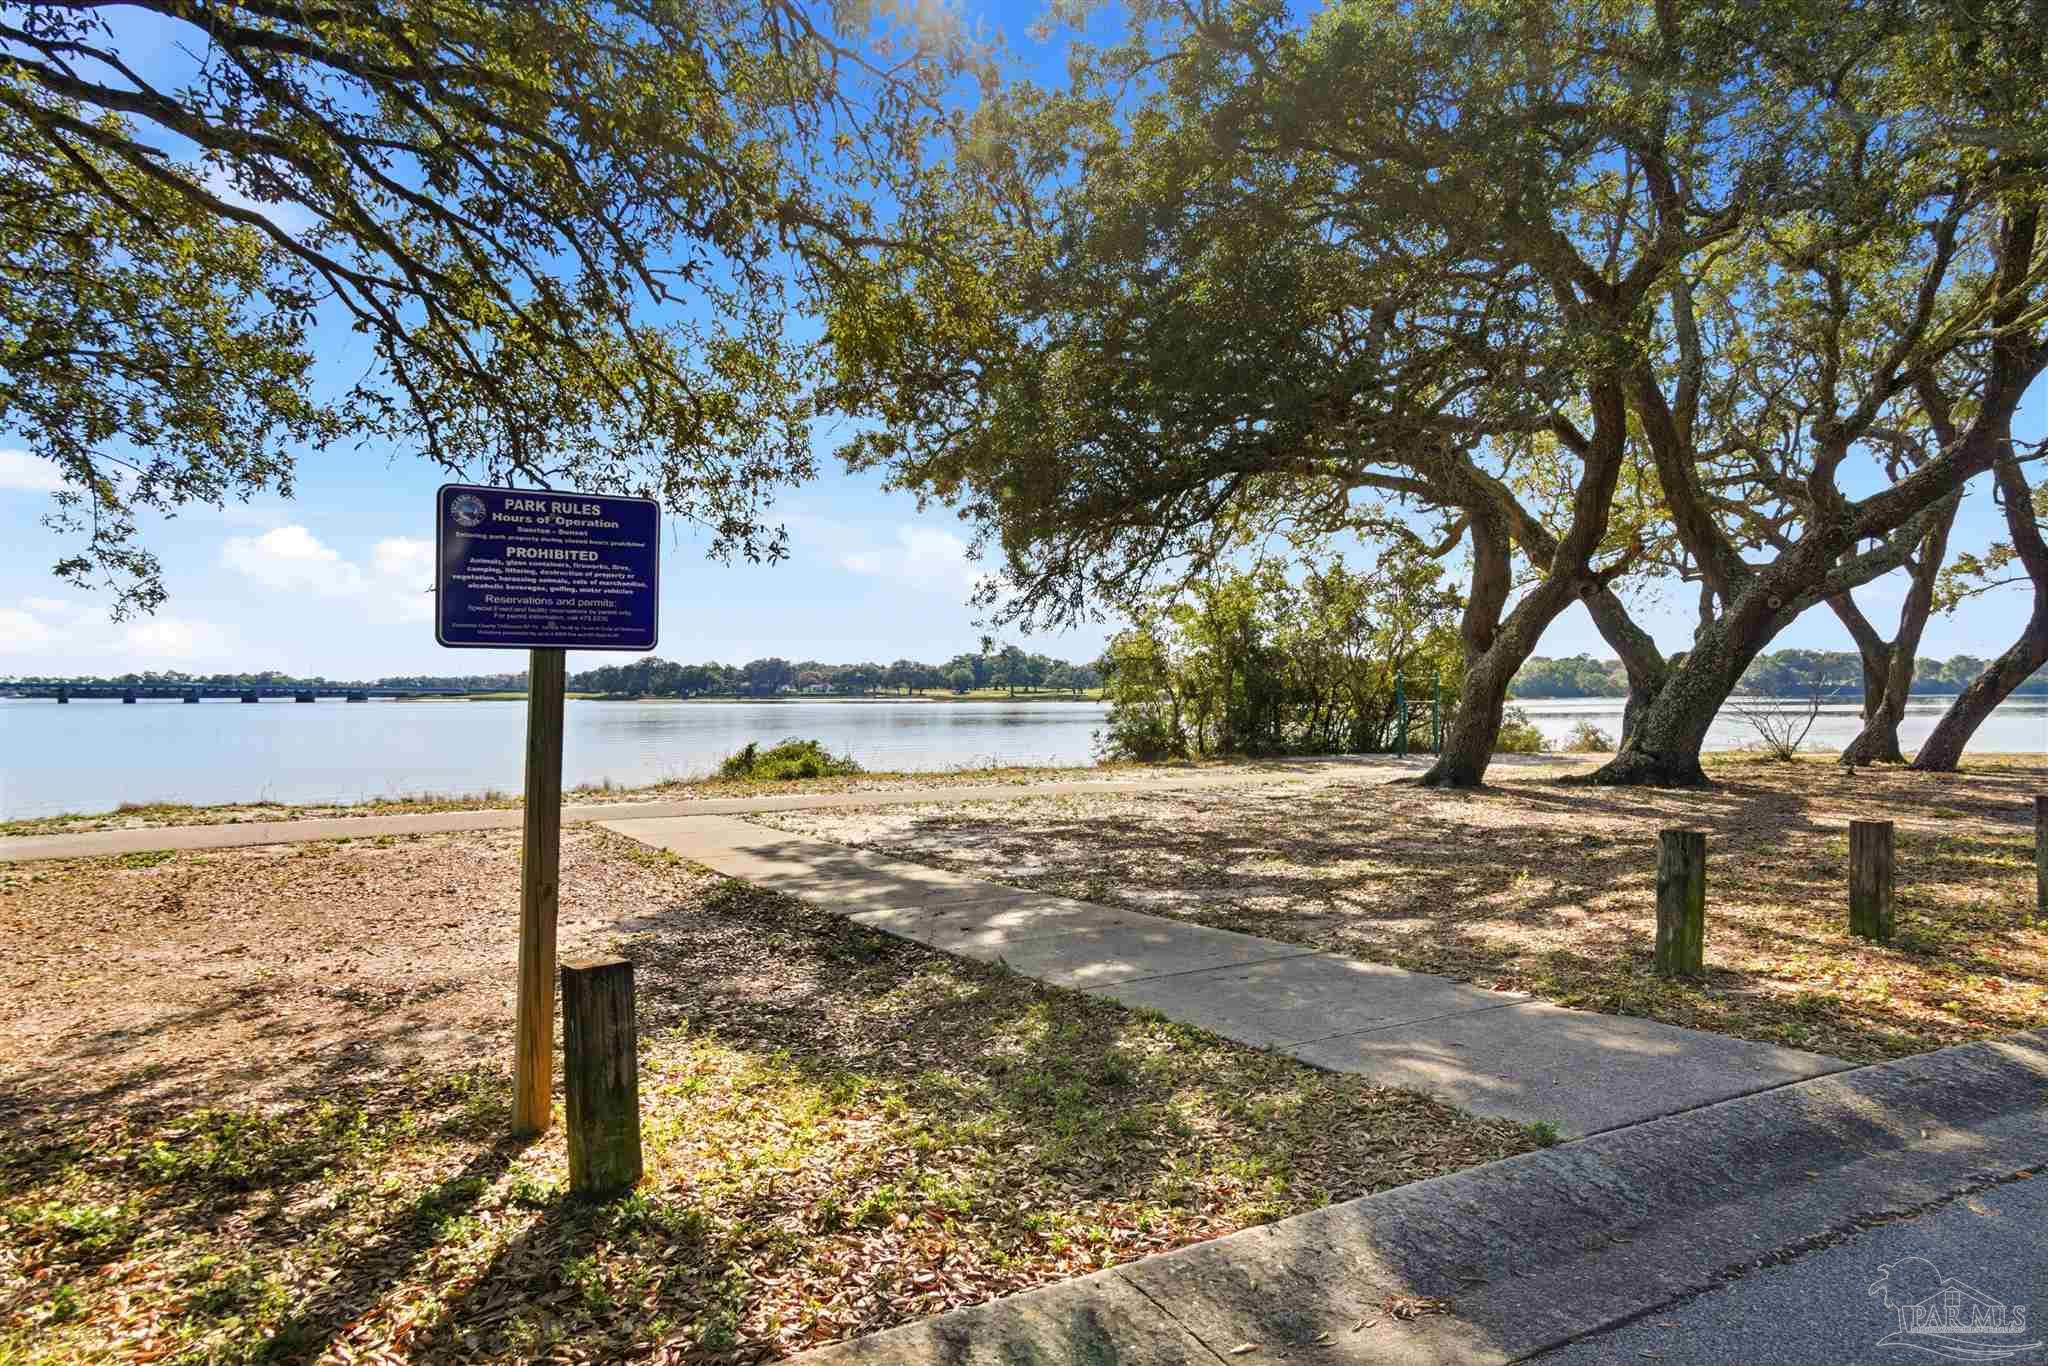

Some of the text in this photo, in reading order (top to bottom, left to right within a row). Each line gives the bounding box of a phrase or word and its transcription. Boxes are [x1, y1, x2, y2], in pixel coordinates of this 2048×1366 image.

[504, 498, 547, 512] PARK
[552, 502, 601, 516] RULES
[492, 512, 620, 528] Hours of Operation
[506, 546, 598, 561] PROHIBITED
[486, 594, 554, 605] Reservations
[578, 600, 616, 608] permits:
